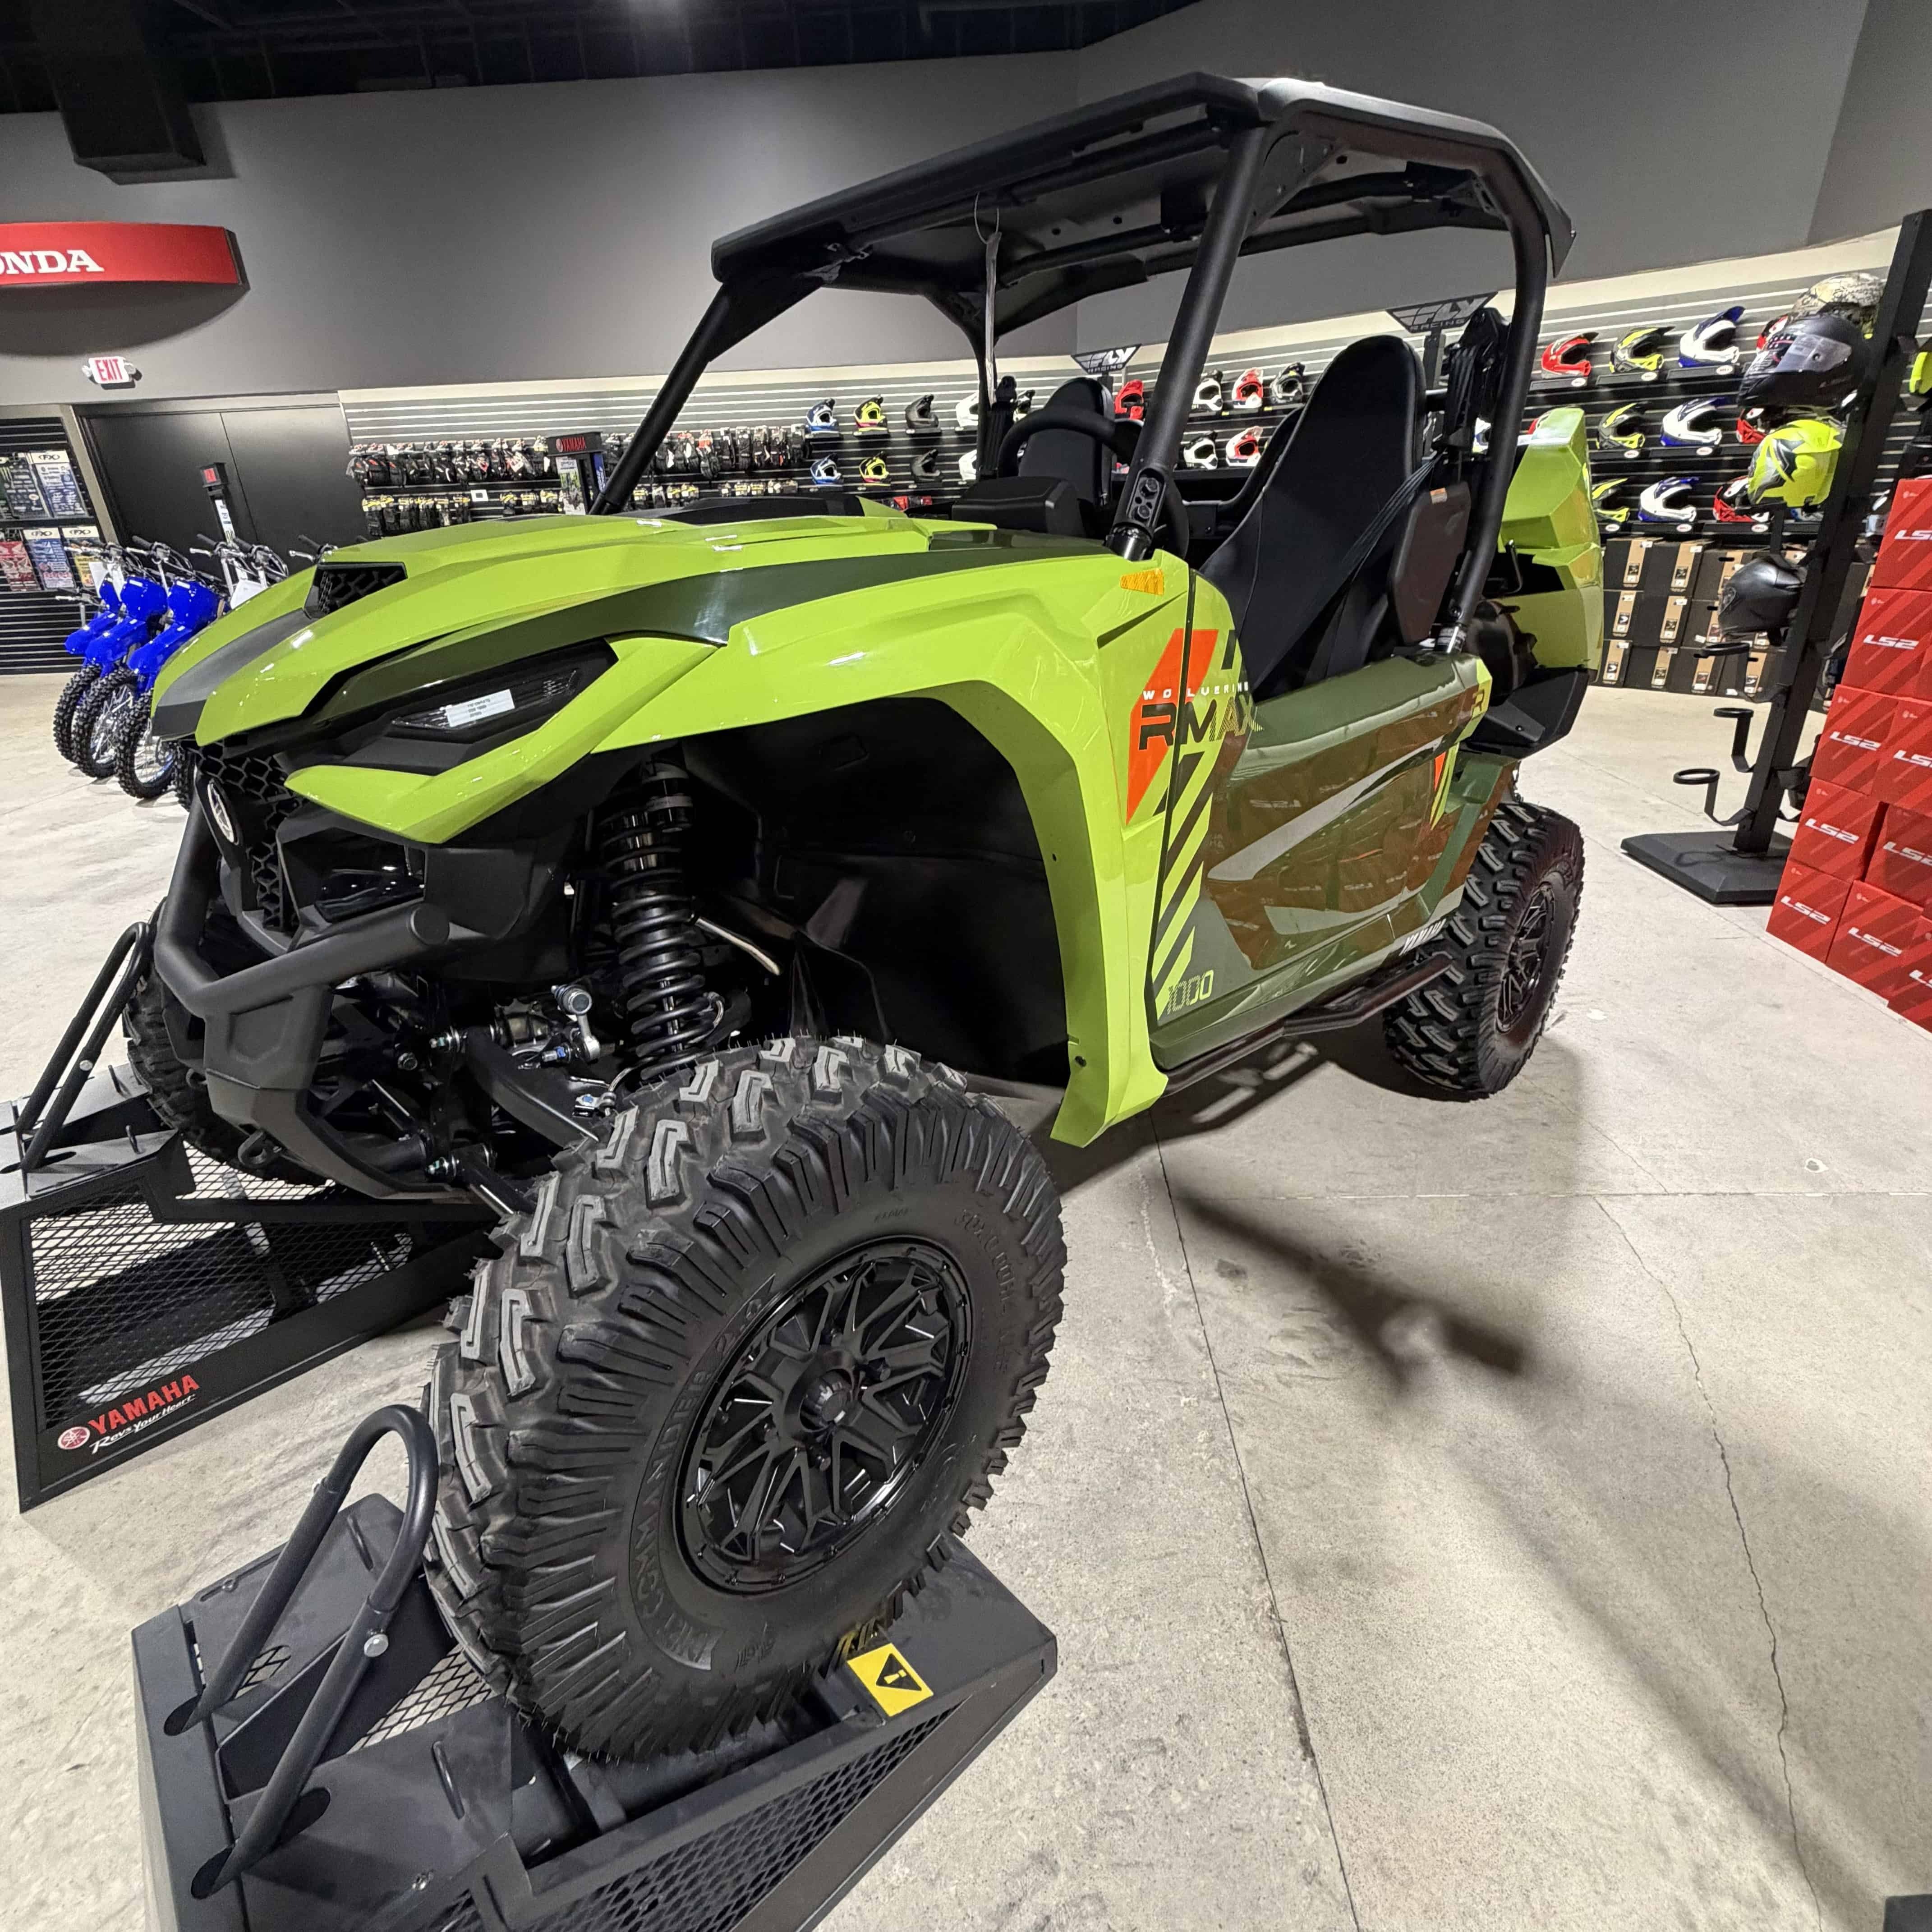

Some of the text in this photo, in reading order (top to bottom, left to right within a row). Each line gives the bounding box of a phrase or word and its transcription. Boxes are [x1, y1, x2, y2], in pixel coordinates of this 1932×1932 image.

[0, 249, 105, 274] NDA
[1410, 318, 1465, 332] RACING
[95, 359, 123, 381] EXIT
[562, 436, 586, 451] YAMAHA
[1895, 529, 1932, 540] LS
[1863, 634, 1919, 650] LS2
[1143, 681, 1249, 700] WOLVERINE
[1139, 694, 1265, 750] RMAX
[1830, 731, 1881, 751] LS2
[1893, 750, 1932, 768] LS
[1805, 818, 1859, 844] LS2
[1780, 896, 1831, 925] LS2
[1849, 927, 1903, 957] LS2
[88, 1374, 200, 1435] YAMAHA
[90, 1426, 133, 1454] Revs
[133, 1410, 163, 1433] Your
